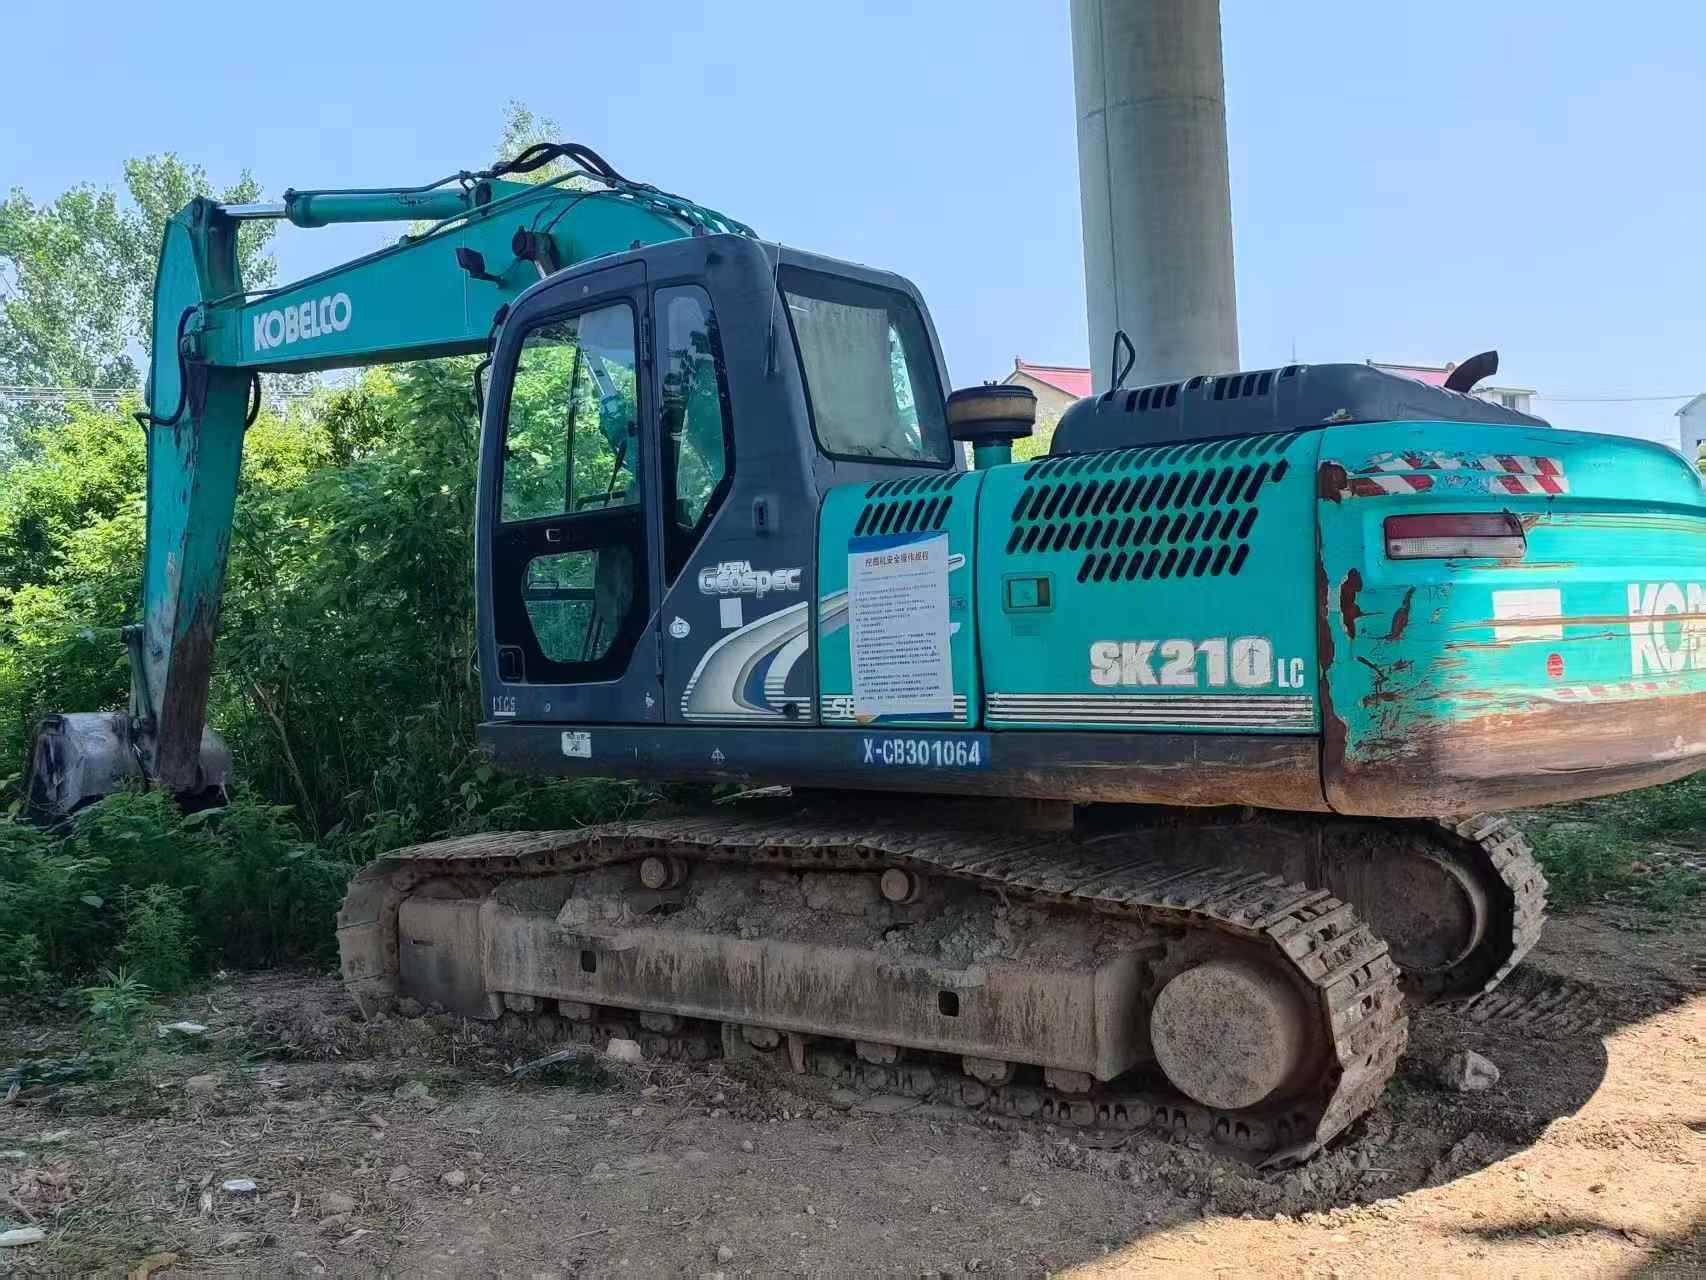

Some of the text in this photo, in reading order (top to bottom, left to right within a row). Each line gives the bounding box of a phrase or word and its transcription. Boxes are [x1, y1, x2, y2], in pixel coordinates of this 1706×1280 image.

[253, 292, 351, 352] KOBELCO
[1089, 637, 1304, 688] SK210 LC
[863, 738, 980, 766] X-CB301064
